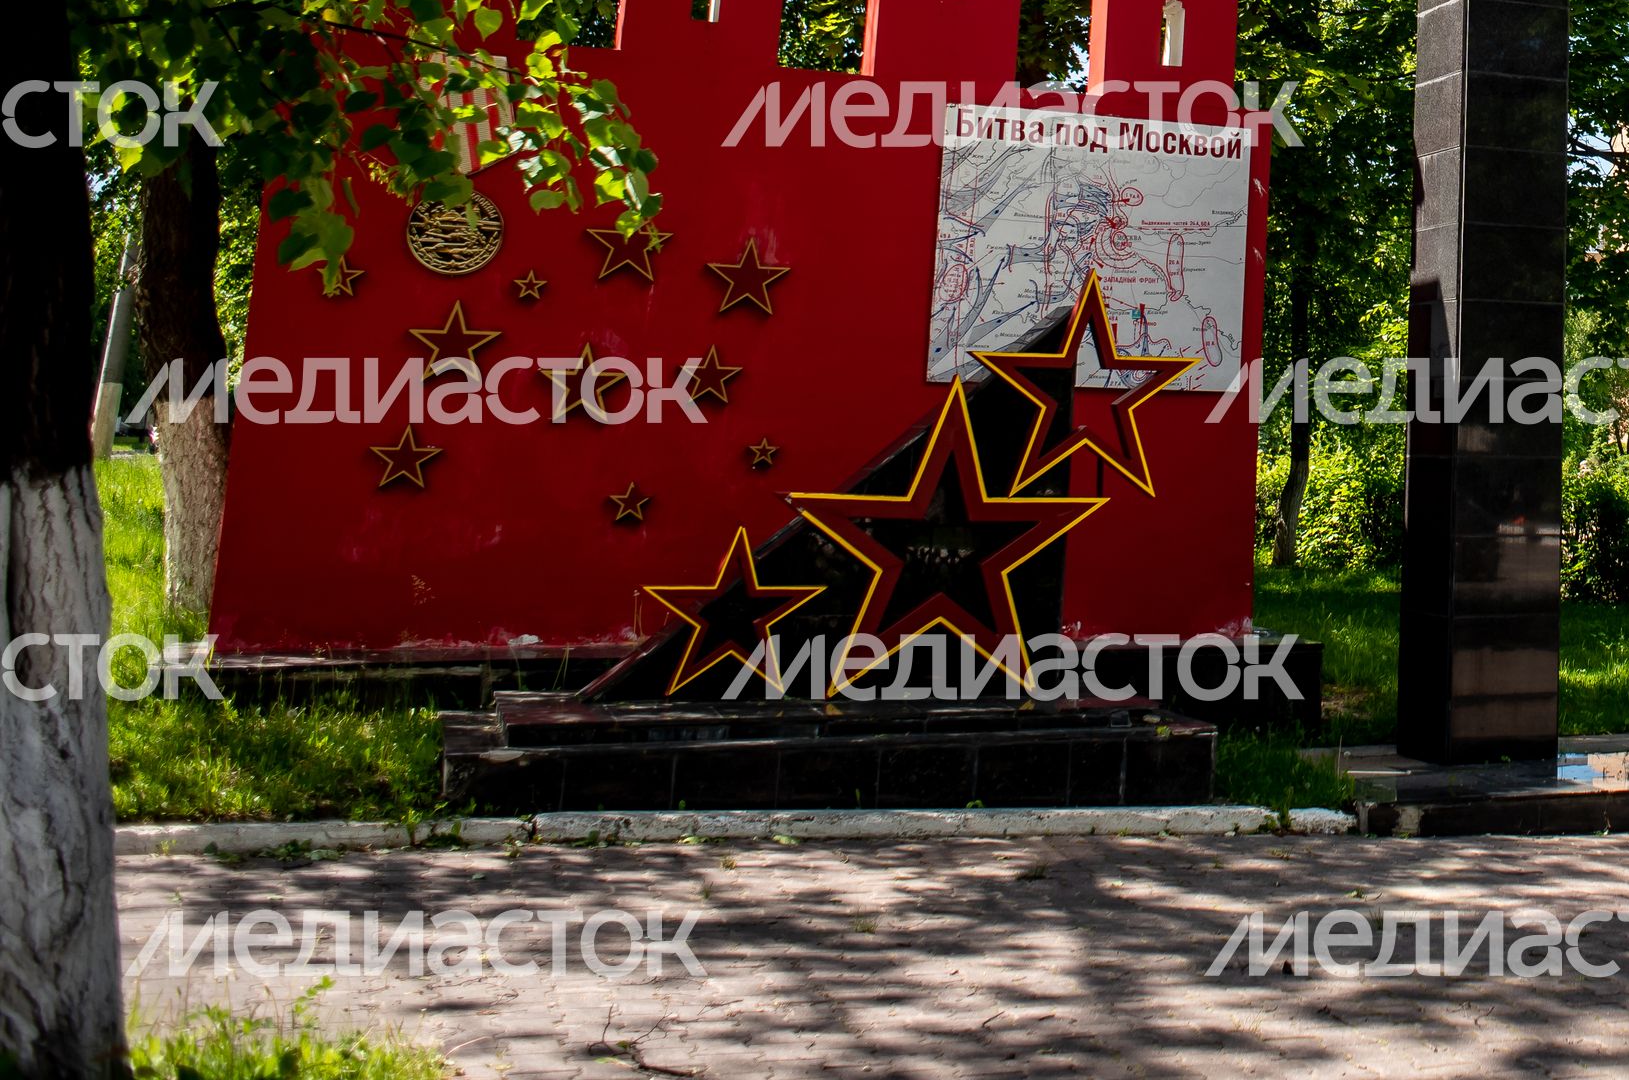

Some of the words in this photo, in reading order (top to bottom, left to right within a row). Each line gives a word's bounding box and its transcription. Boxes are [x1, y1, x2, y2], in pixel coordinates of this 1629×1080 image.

[957, 108, 1044, 143] Битва
[1055, 123, 1108, 153] под
[1119, 122, 1242, 159] Москвой
[1138, 276, 1159, 284] ФРОНТ
